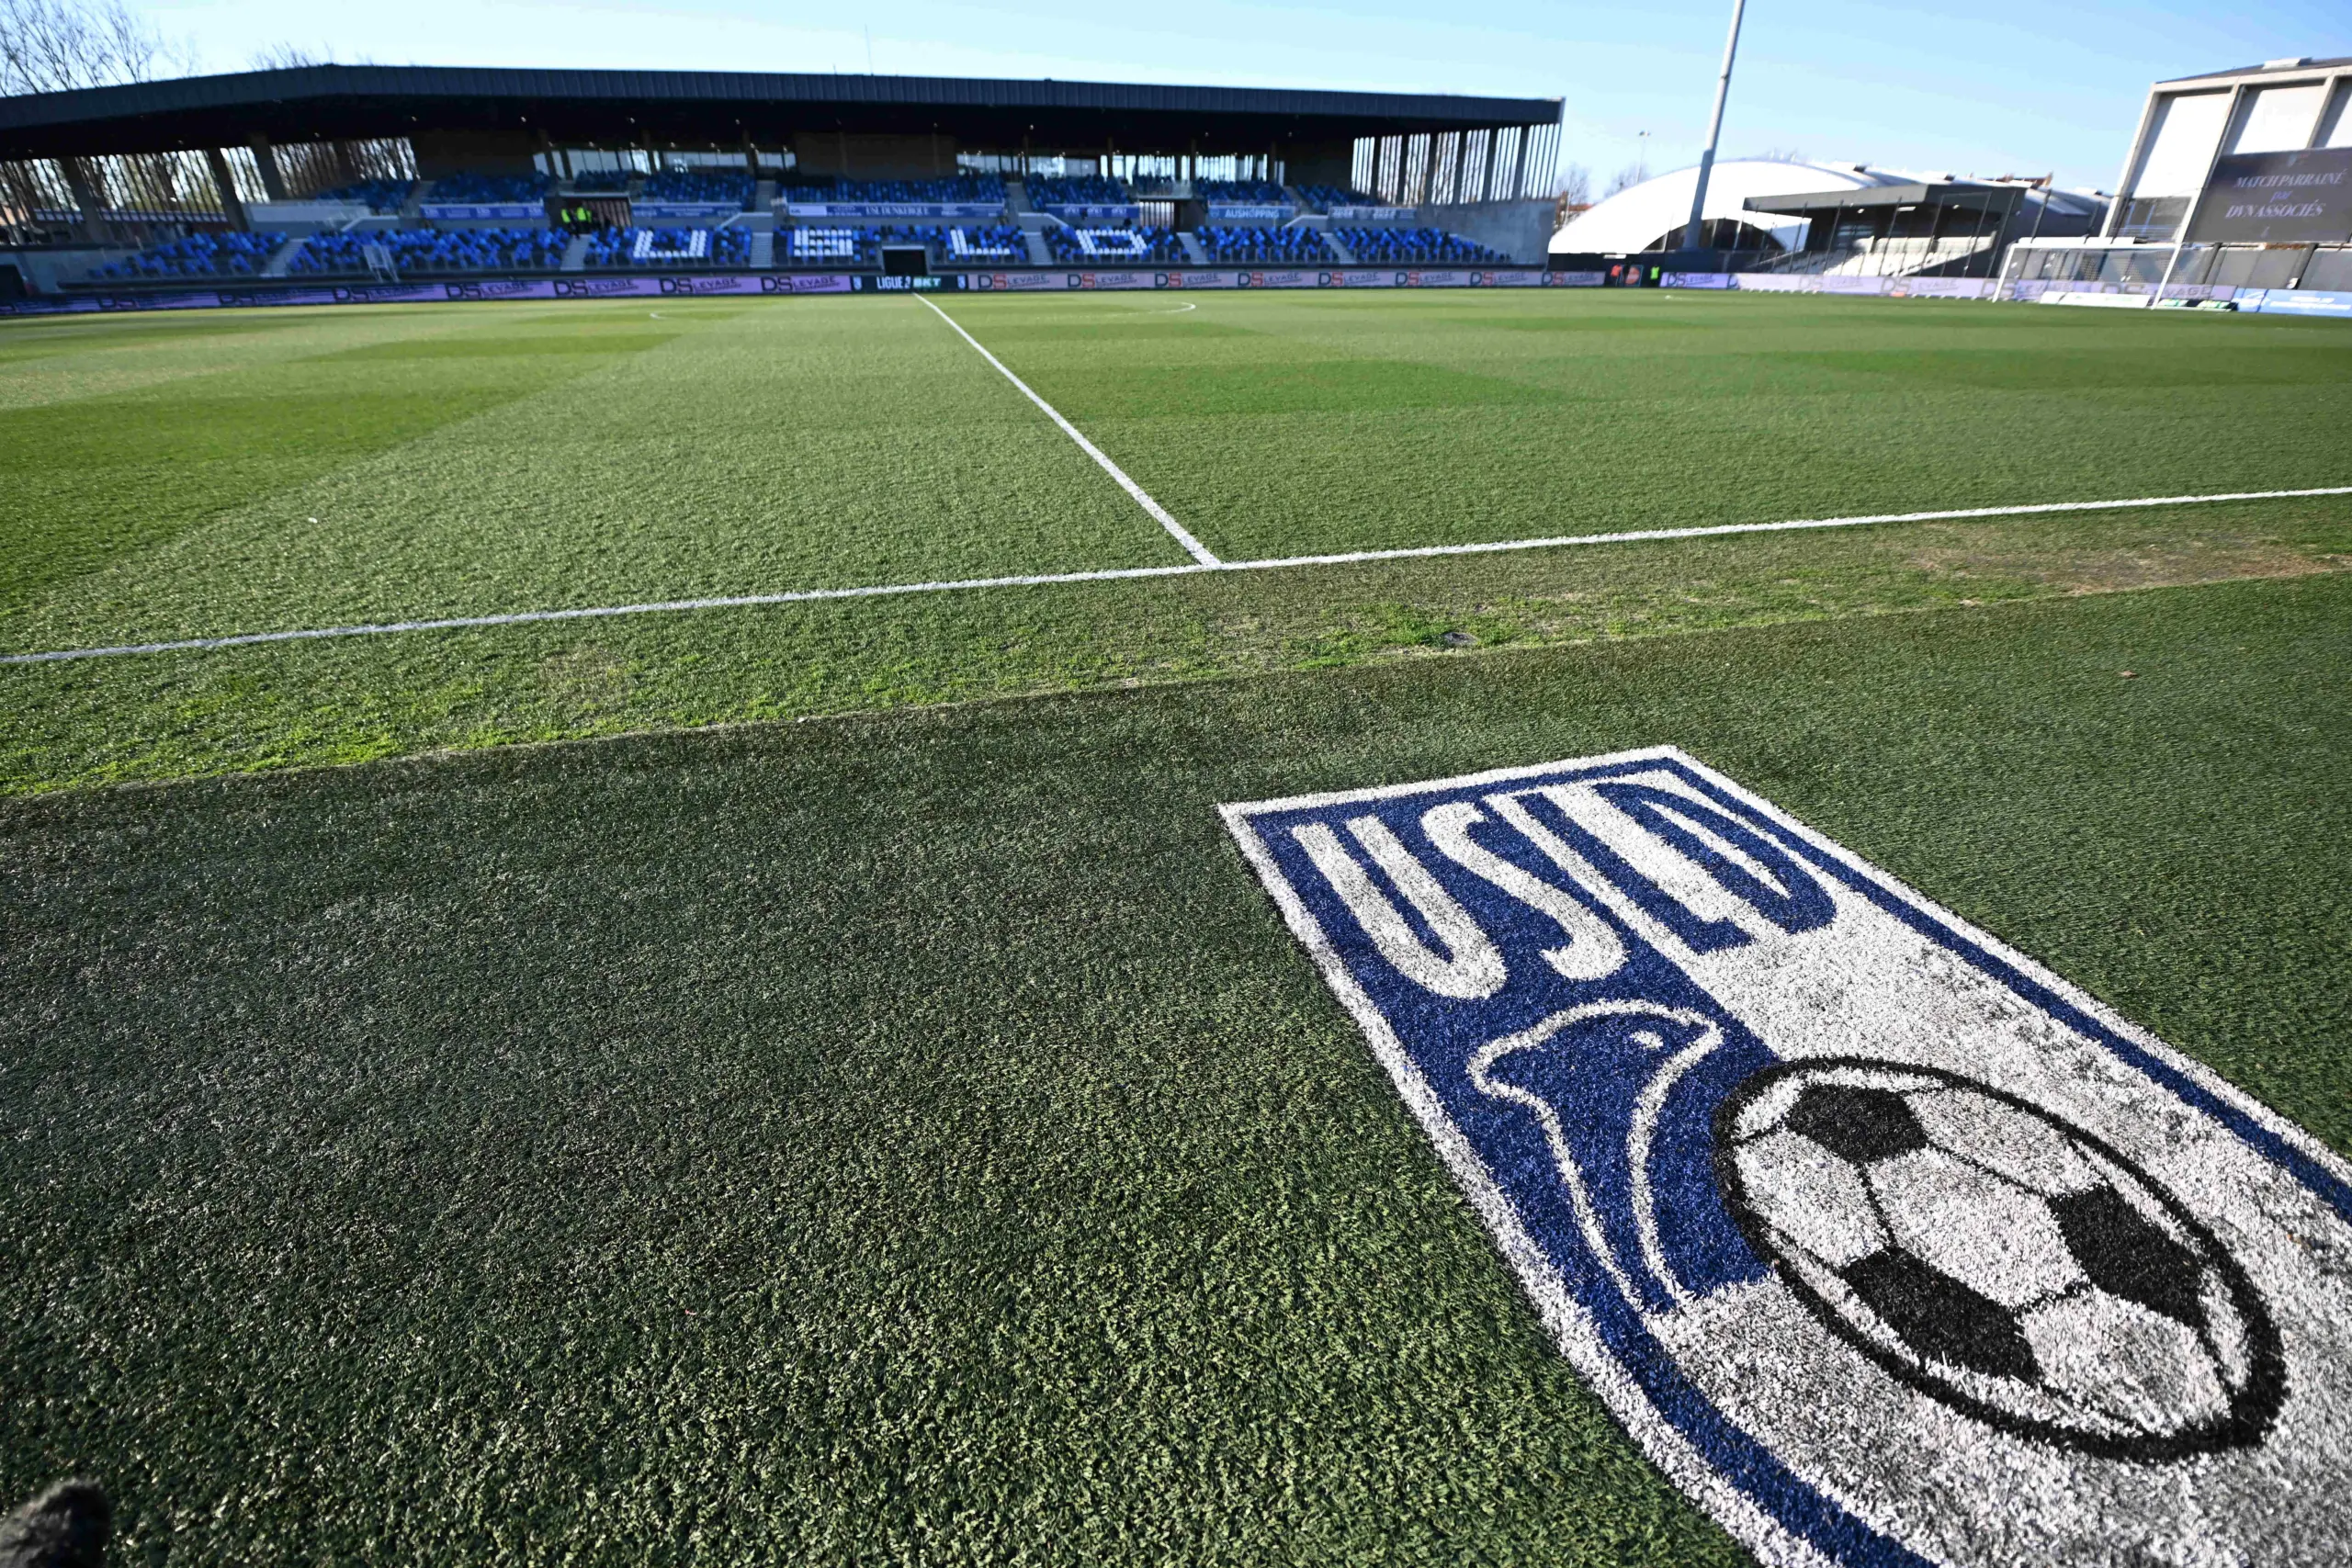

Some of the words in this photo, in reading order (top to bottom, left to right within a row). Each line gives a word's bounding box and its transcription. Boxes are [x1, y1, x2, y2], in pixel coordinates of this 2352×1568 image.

[2233, 175, 2278, 187] MATCH
[660, 277, 694, 293] DS
[761, 276, 793, 291] DS
[876, 276, 903, 289] LIGUE
[903, 276, 911, 289] 2
[913, 277, 941, 288] BKT
[978, 274, 1008, 289] DS
[1068, 274, 1095, 288] DS
[1154, 272, 1182, 288] DS
[1238, 272, 1263, 287] DS
[1317, 272, 1343, 287] DS
[1395, 272, 1419, 286] DS
[553, 279, 589, 296] DS
[1291, 781, 1838, 1000] USLD
